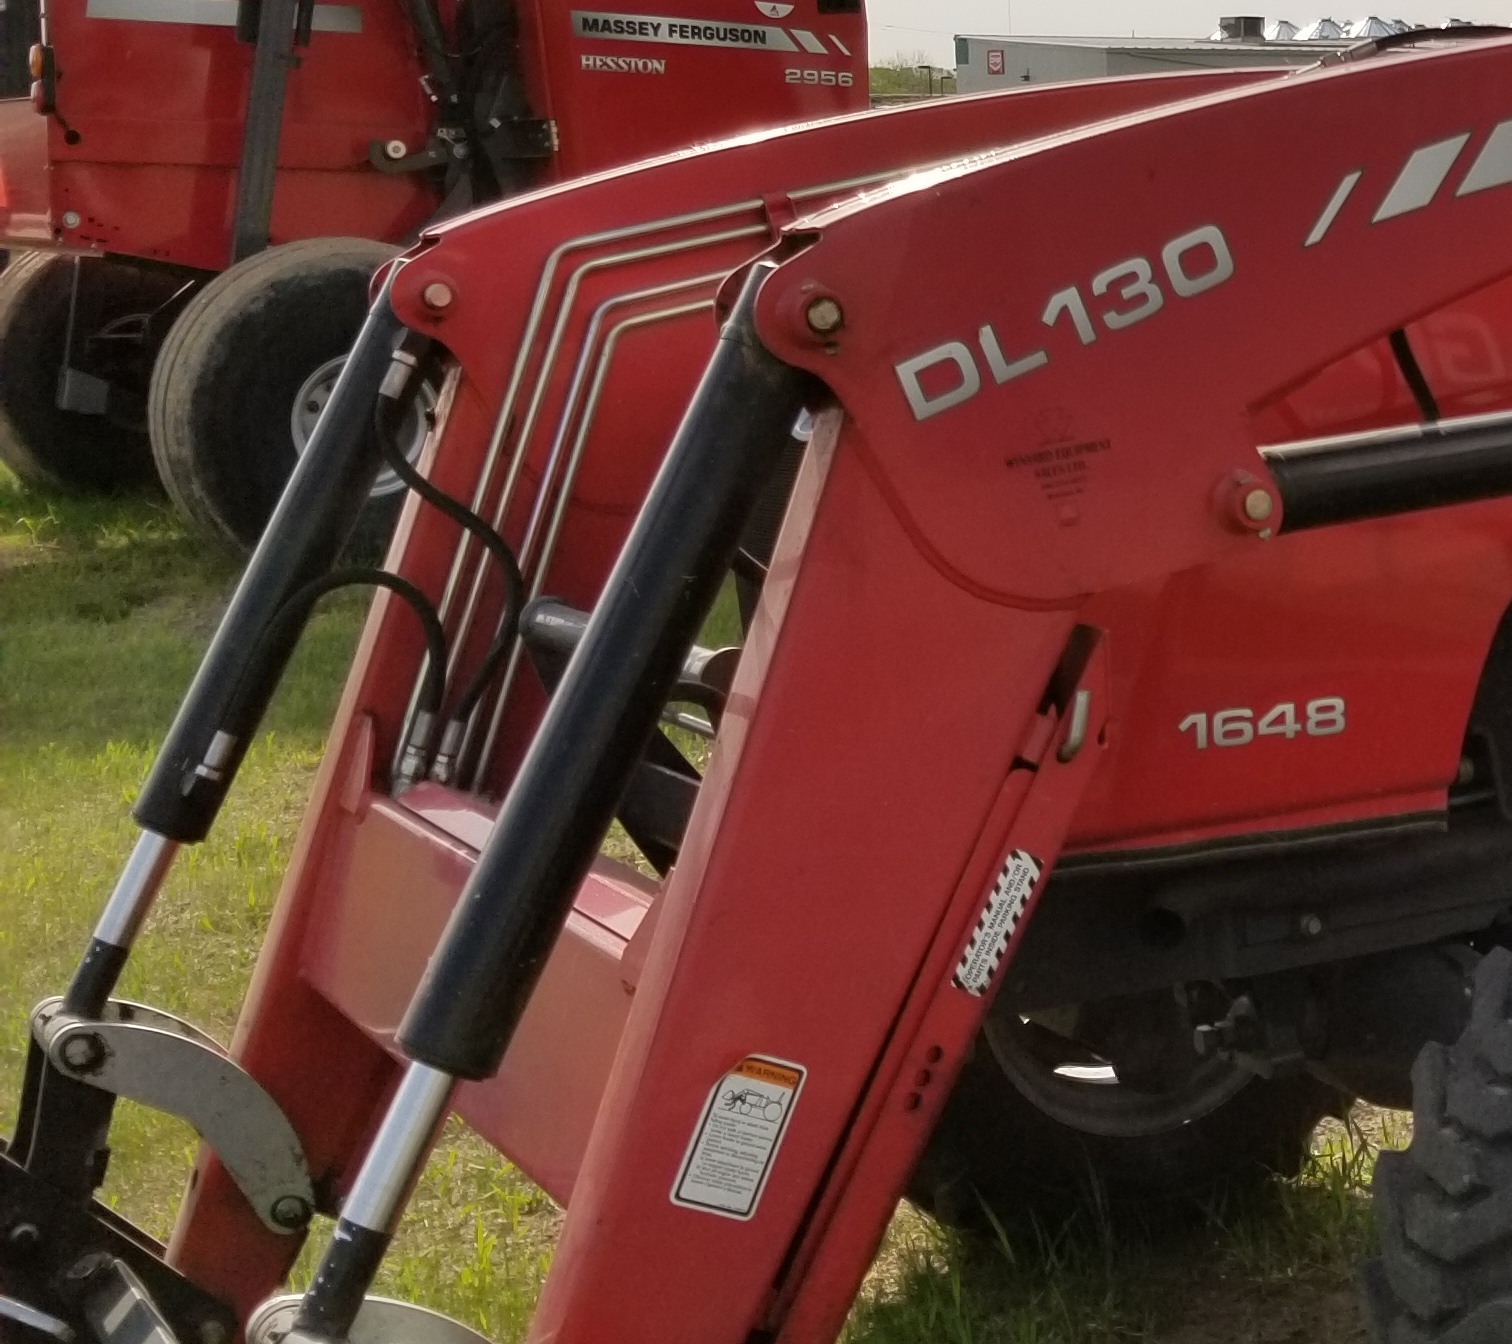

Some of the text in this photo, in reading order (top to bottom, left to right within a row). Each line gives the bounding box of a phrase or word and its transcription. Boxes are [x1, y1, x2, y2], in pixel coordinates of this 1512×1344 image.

[582, 17, 767, 45] MASSEY FERGUSON
[581, 54, 666, 75] HESSTON
[784, 68, 854, 88] 2956
[894, 224, 1235, 422] DL130
[1178, 697, 1346, 749] 1648
[965, 863, 1023, 980] OPERATOR'S MANUAL AND/OR
[972, 867, 1029, 983] PARTS INSIDE PARKING STAND
[747, 1065, 798, 1085] WARNING
